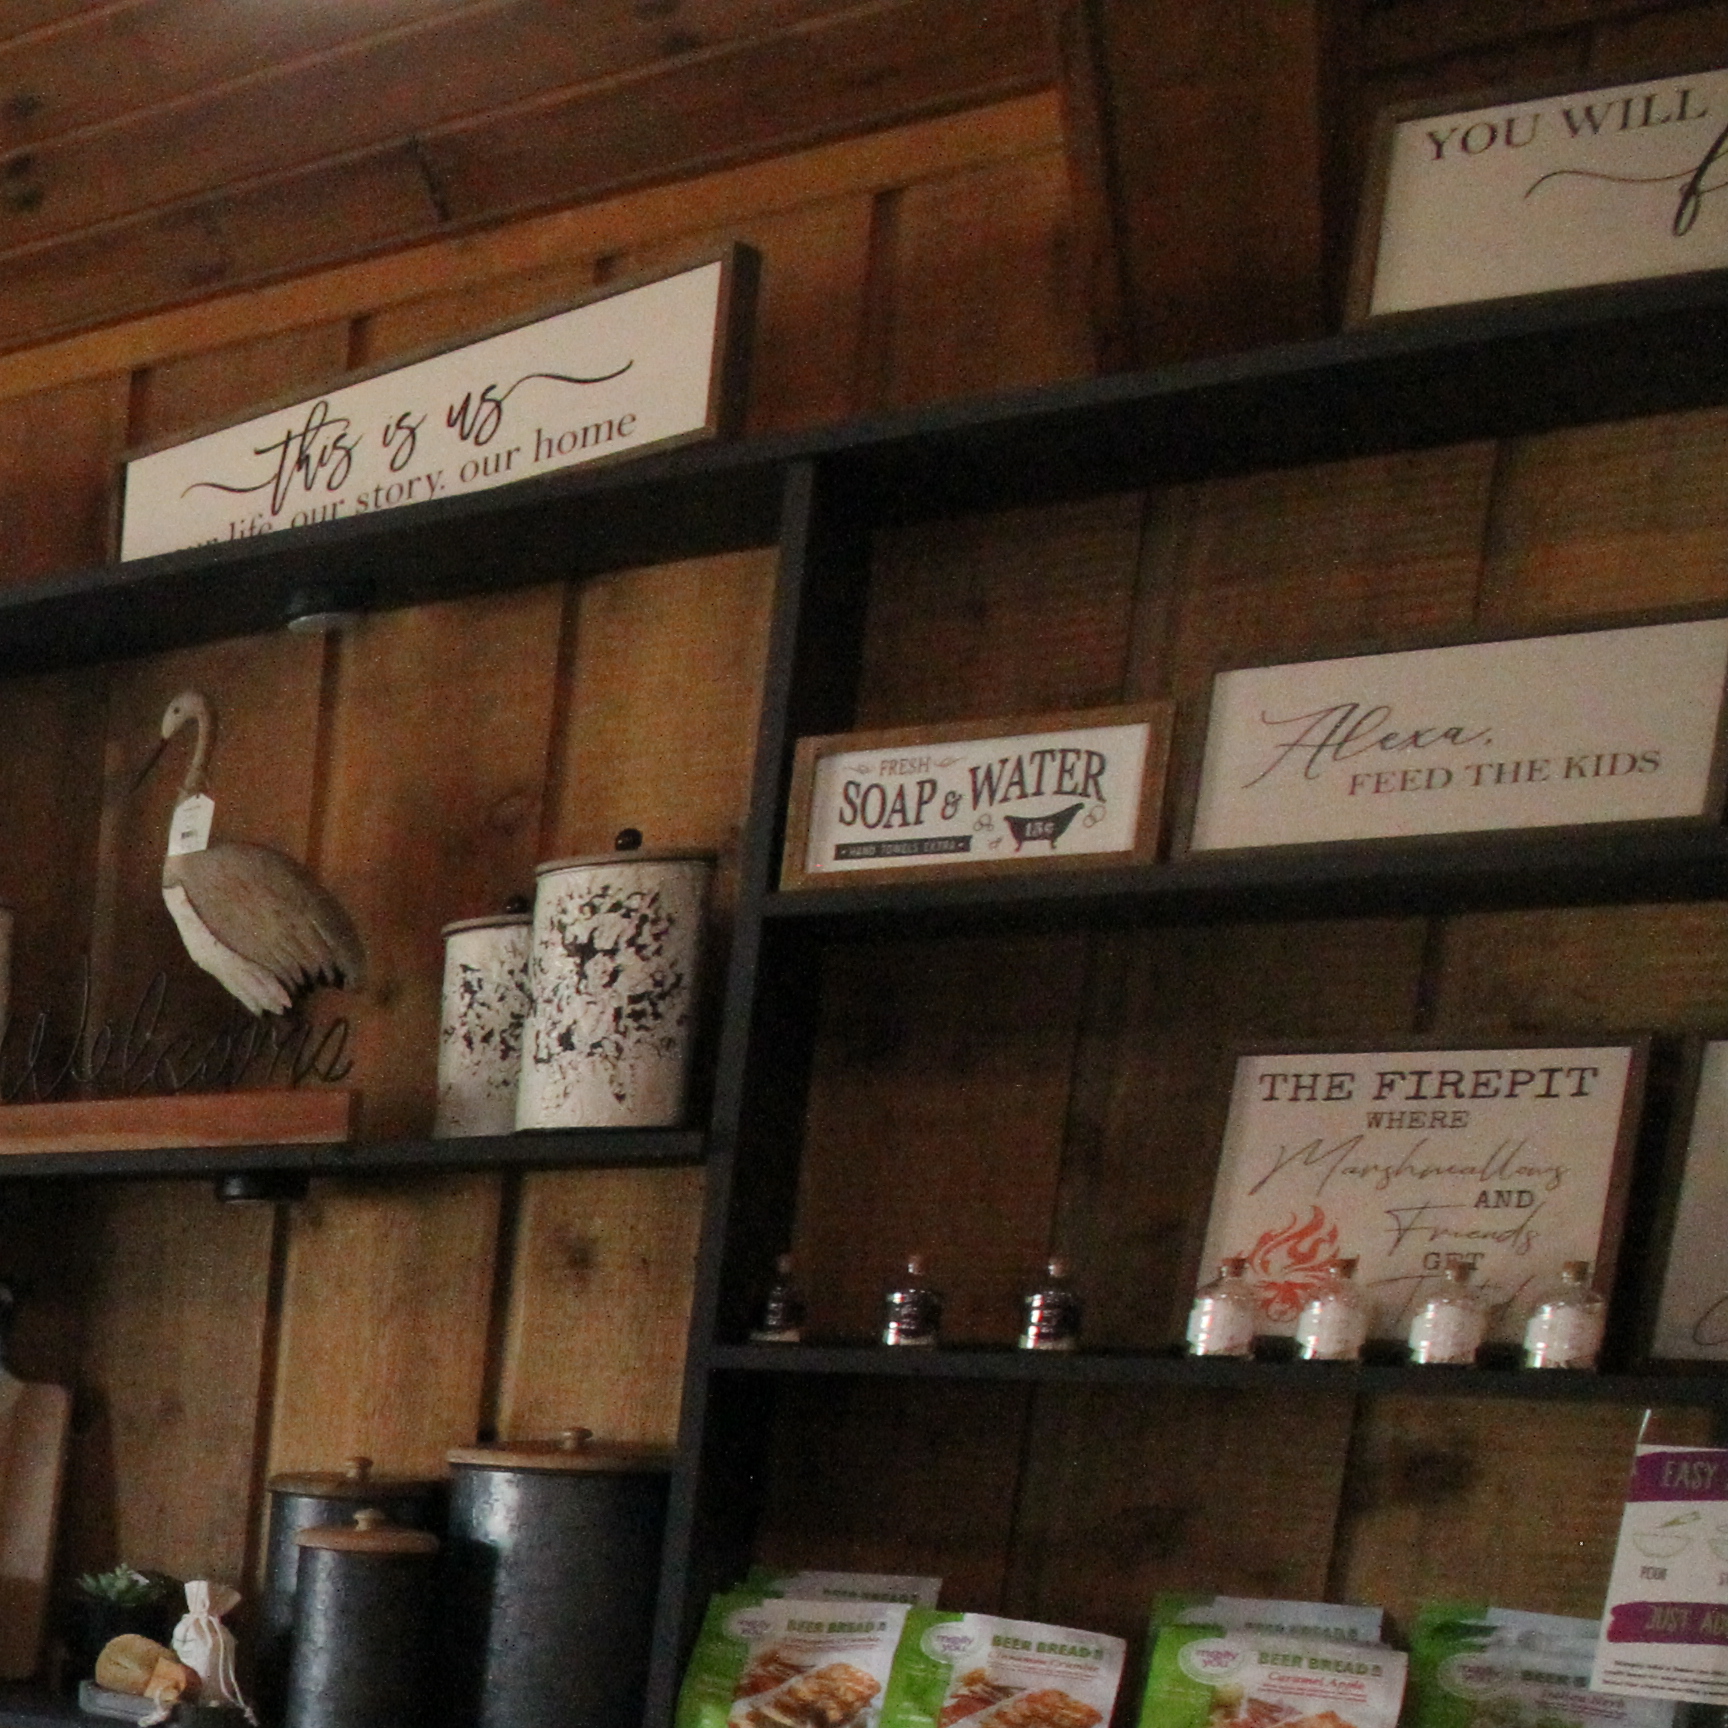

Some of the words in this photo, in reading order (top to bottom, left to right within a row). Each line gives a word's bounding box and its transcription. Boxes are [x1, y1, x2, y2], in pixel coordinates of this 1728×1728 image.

[1426, 113, 1541, 160] YOU
[1562, 88, 1709, 139] WILL
[253, 401, 359, 515] this
[382, 411, 427, 471] is
[460, 447, 519, 483] our
[534, 412, 636, 463] home
[879, 757, 931, 775] FRESH
[1348, 767, 1453, 796] FEED
[1465, 759, 1550, 787] THE
[1563, 750, 1661, 779] KIDS
[839, 778, 938, 829] SOAP
[941, 790, 962, 820] &
[969, 748, 1107, 811] WATER
[1258, 1072, 1355, 1102] THE
[1372, 1066, 1599, 1100] FIREPIT
[1366, 1110, 1469, 1130] WHERE
[1248, 1134, 1571, 1196] Marshmallows
[1473, 1189, 1536, 1210] AND
[1384, 1199, 1546, 1257] Friends
[1662, 1461, 1718, 1488] EASY
[1639, 1565, 1667, 1581] POUR
[1646, 1605, 1690, 1632] JUST
[992, 1635, 1032, 1651] BEER
[1036, 1641, 1091, 1658] BREAD
[1258, 1652, 1303, 1668] BEER
[1307, 1658, 1368, 1676] BREAD
